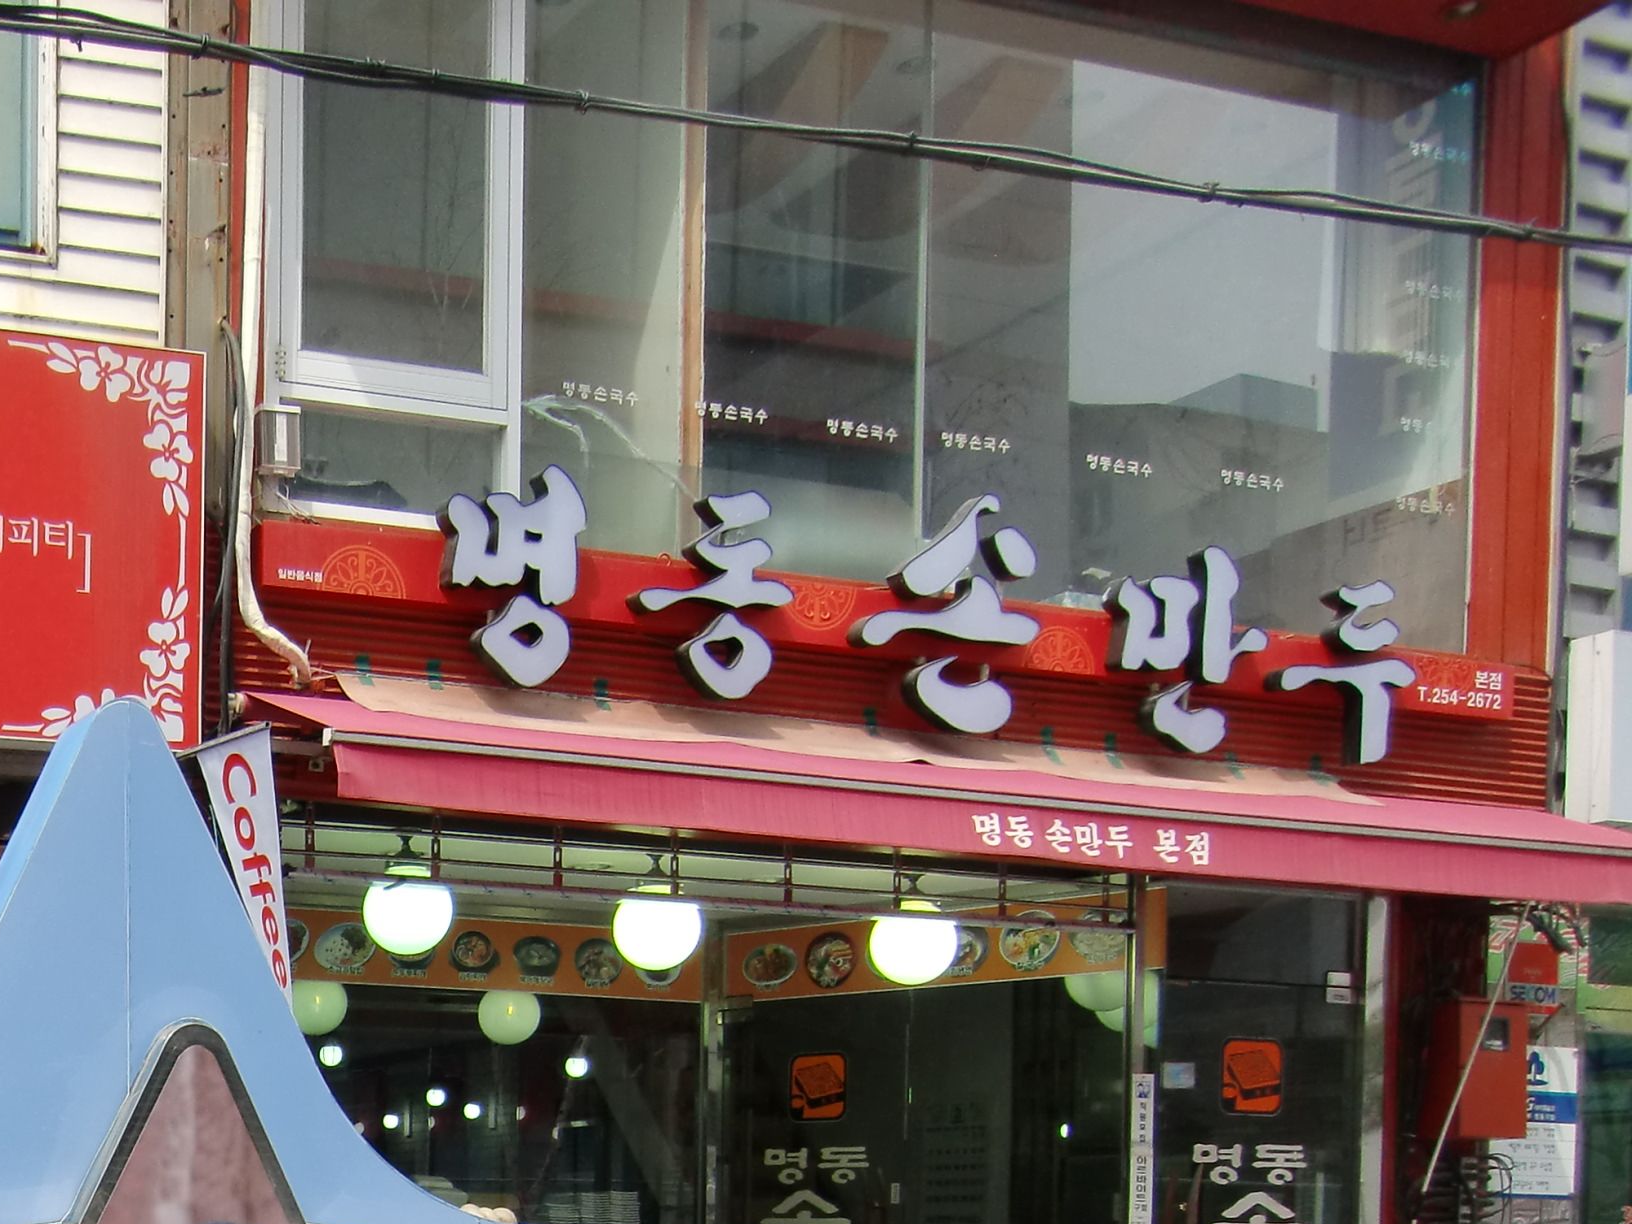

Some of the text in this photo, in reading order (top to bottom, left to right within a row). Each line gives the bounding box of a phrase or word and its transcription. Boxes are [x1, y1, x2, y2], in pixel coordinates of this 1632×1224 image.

[562, 381, 639, 407] 명동손국수
[694, 401, 768, 425] 명동손국수
[826, 418, 899, 443] 명동손국수
[941, 431, 1011, 454] 명동손국수
[1086, 453, 1153, 478] 명동손국수
[1220, 469, 1284, 492] 명동손국수
[1475, 671, 1502, 690] 본점
[1417, 686, 1501, 710] T.254-2672
[971, 812, 1210, 866] 명동 손만두 본점
[221, 753, 288, 990] Coffee
[763, 1146, 870, 1186] 명동
[1192, 1143, 1308, 1186] 명동
